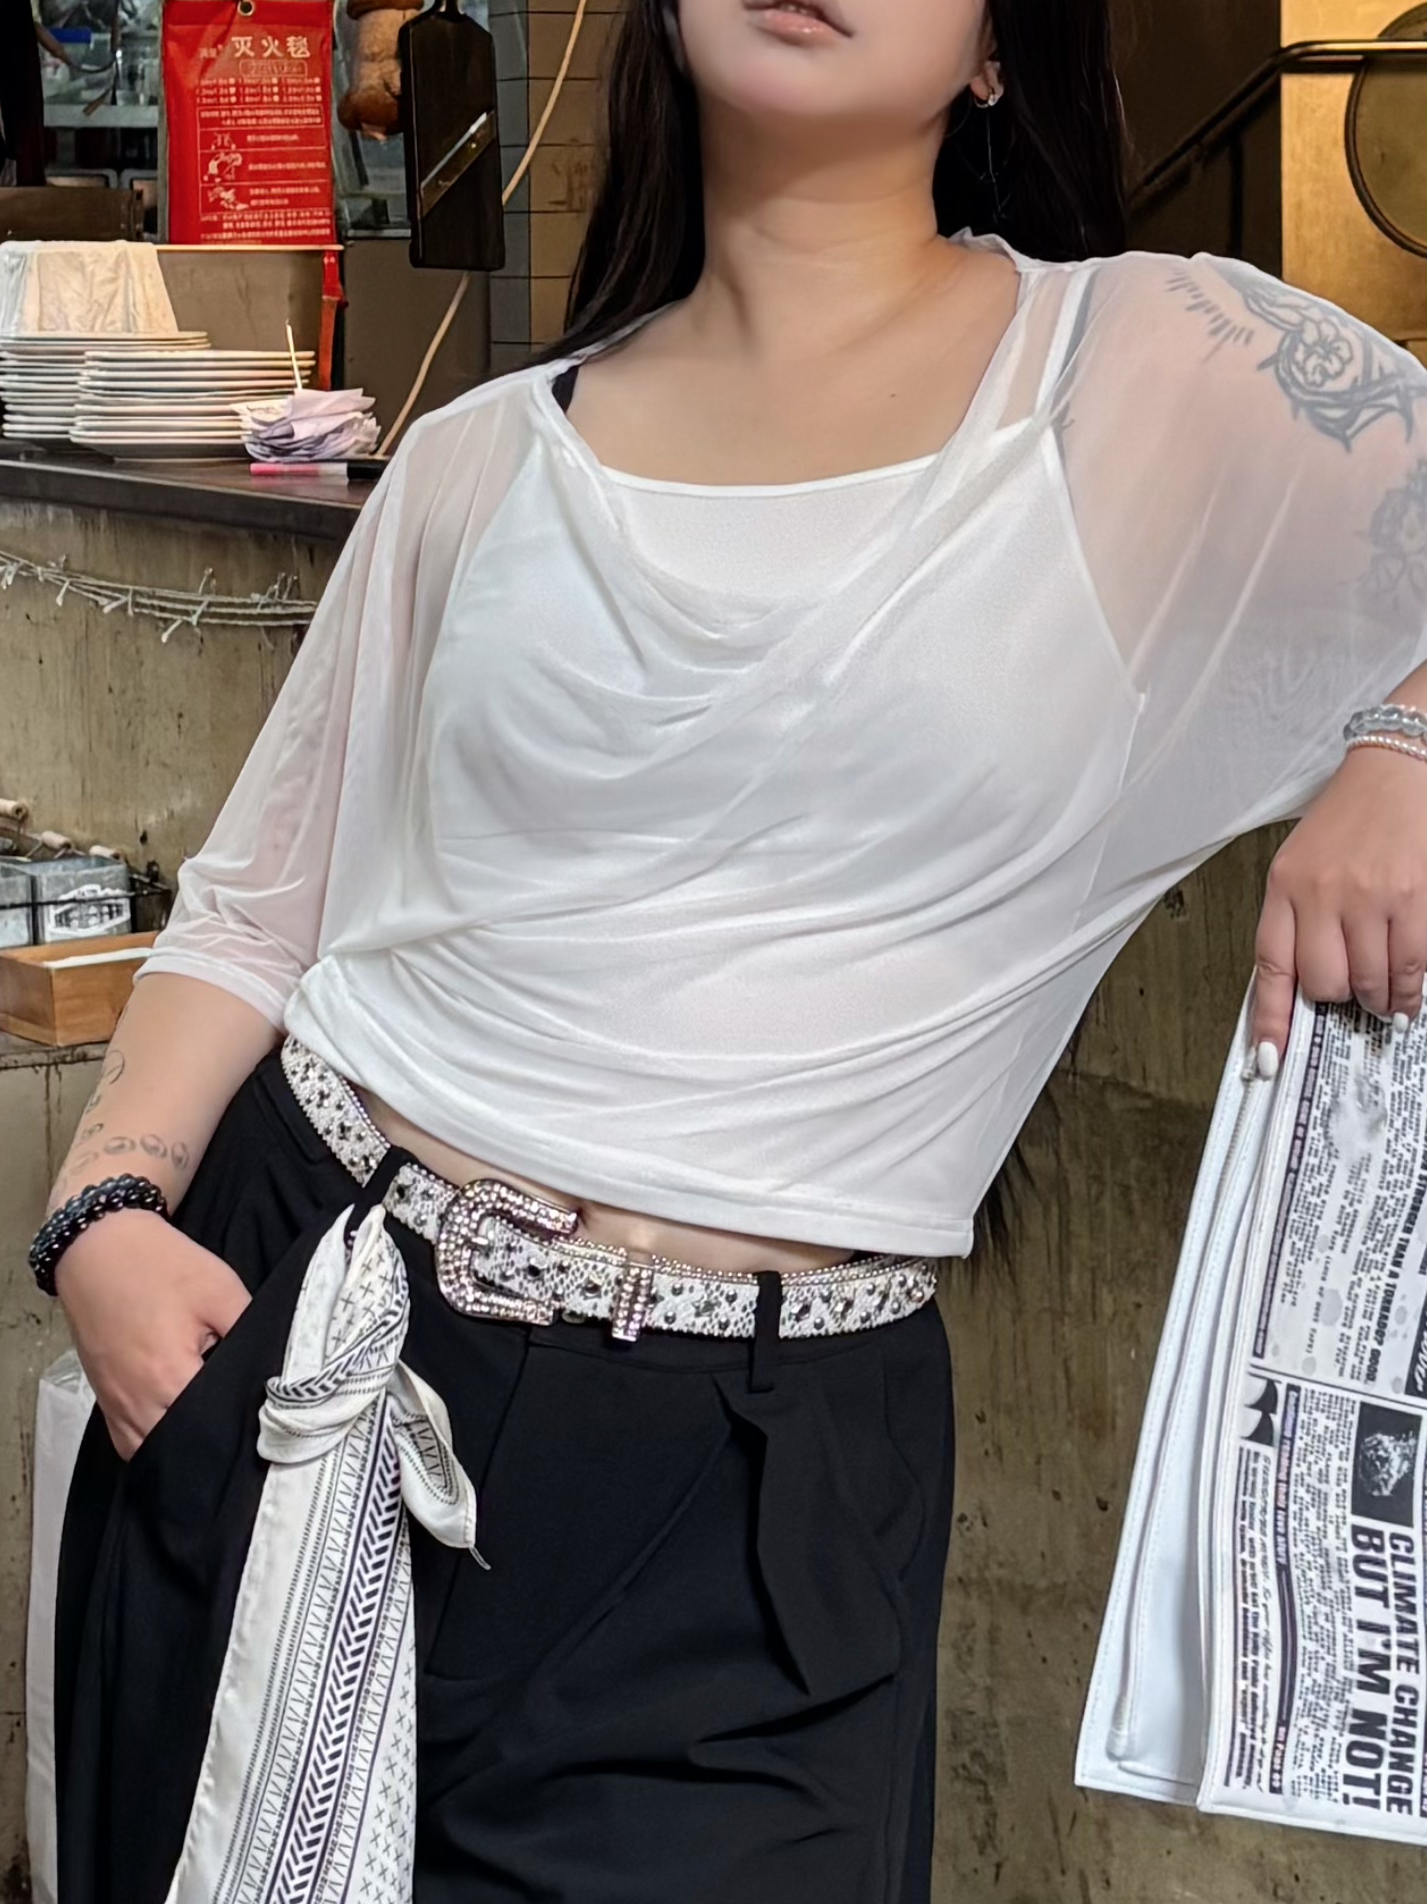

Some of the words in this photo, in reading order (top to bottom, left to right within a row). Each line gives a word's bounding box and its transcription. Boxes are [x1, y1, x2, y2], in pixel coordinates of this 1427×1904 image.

[231, 36, 311, 59] 灭火毯
[1351, 1524, 1388, 1609] BUT
[1389, 1532, 1419, 1673] CLIMATE
[1355, 1619, 1391, 1695] I'M
[1342, 1708, 1386, 1809] NOT!
[1385, 1683, 1418, 1815] CHANGE
